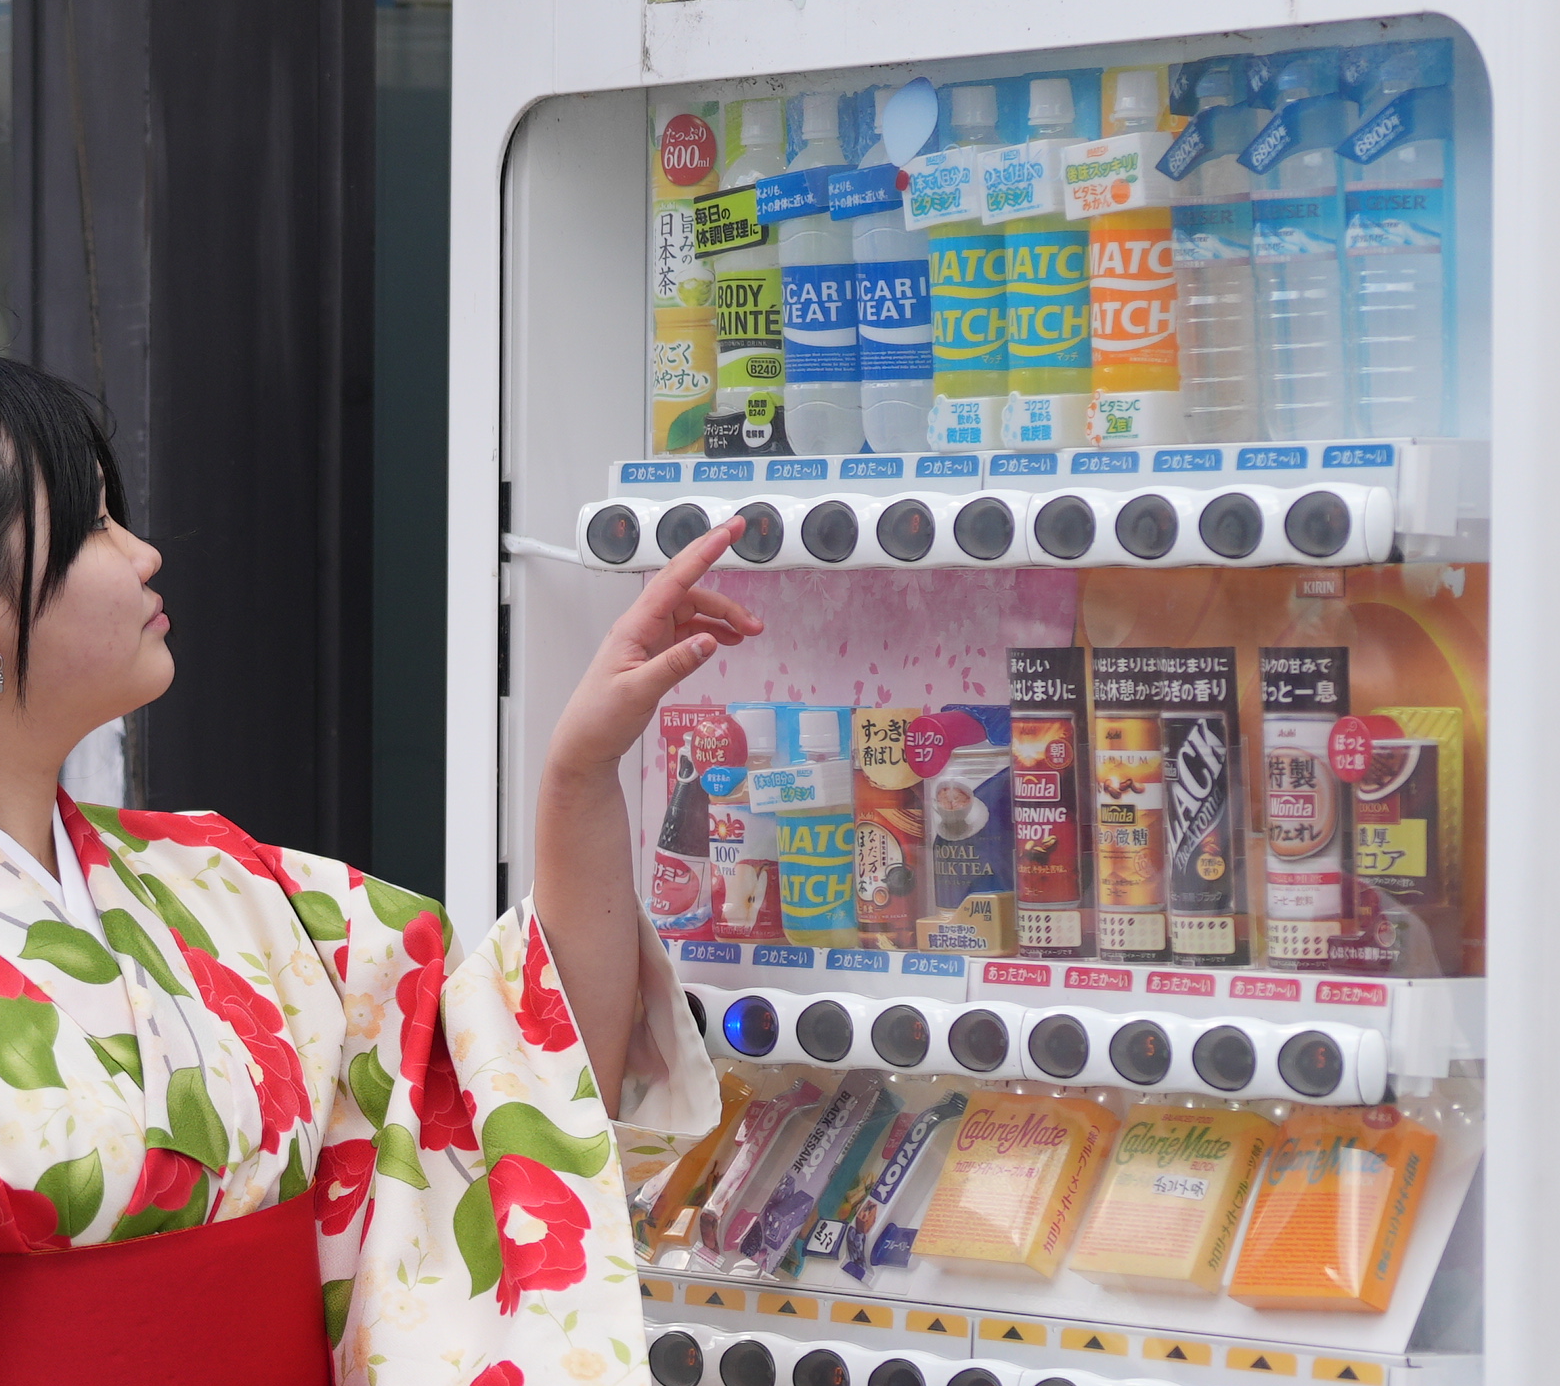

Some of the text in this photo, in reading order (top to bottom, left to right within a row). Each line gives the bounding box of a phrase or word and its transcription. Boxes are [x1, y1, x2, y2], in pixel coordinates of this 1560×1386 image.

[666, 126, 707, 144] たっぷり
[664, 144, 710, 169] 600ml
[987, 184, 1034, 211] ビタミン!
[1073, 184, 1108, 199] ビタミン
[912, 190, 960, 215] ビタミン!
[1082, 197, 1111, 211] みかん
[695, 204, 731, 226] 毎日の
[680, 213, 694, 265] 旨みの
[696, 219, 759, 249] 体調管理に
[659, 213, 677, 296] 日本茶
[718, 284, 764, 308] BODY
[982, 353, 1002, 363] マッチ
[1057, 352, 1079, 362] マッチ
[750, 364, 778, 376] B240
[749, 409, 766, 417] B240
[951, 403, 979, 413] ゴクゴク
[1025, 399, 1051, 412] ゴクゴク
[1099, 399, 1141, 413] ビタミンC
[957, 413, 981, 425] 飲める
[1030, 412, 1051, 423] 飲める
[1106, 414, 1133, 434] 2倍!
[946, 427, 982, 444] 微炭酸
[1021, 424, 1052, 442] 微炭酸
[708, 437, 728, 449] サポート
[998, 457, 1051, 473] つめた〜い
[1079, 455, 1132, 471] つめた〜い
[1161, 453, 1215, 469] つめた〜い
[1246, 451, 1300, 467] つめた〜い
[1330, 449, 1387, 465] つめた〜い
[628, 466, 677, 481] つめた〜い
[700, 465, 749, 480] つめた〜い
[773, 464, 821, 479] つめた〜い
[847, 462, 897, 478] つめた〜い
[924, 460, 974, 476] つめた〜い
[1303, 580, 1335, 594] KIRIN
[906, 731, 944, 746] ミルクの
[1278, 728, 1296, 738] Asahi
[1050, 743, 1065, 758] 朝
[1335, 734, 1365, 751] ほっと
[696, 749, 725, 763] おいしさ
[914, 748, 934, 762] コク
[1336, 754, 1366, 771] ひと息
[754, 771, 796, 790] 1本で1日分の
[1268, 758, 1316, 789] 特製
[781, 786, 815, 801] ビタミン!
[1015, 778, 1055, 797] Wonda
[1101, 809, 1134, 822] Wonda
[1271, 799, 1313, 816] Wonda
[709, 814, 745, 839] Dole
[1017, 824, 1053, 840] SHOT
[714, 845, 740, 863] 100%
[868, 829, 878, 873] なだ万
[936, 844, 980, 859] ROYAL
[715, 865, 736, 876] APPLE
[856, 831, 867, 894] ほうじ茶
[962, 862, 994, 876] TEA
[654, 881, 663, 894] C
[970, 900, 992, 916] JAVA
[938, 925, 976, 935] 豊かな香りの
[928, 933, 987, 949] 贅沢な味わい
[688, 946, 735, 960] つめた〜い
[760, 949, 808, 963] つめた〜い
[833, 953, 883, 968] つめた〜い
[909, 958, 958, 973] つめた〜い
[988, 968, 1047, 983] あったか〜い
[1069, 971, 1129, 988] あったか〜い
[1151, 976, 1211, 992] あったか〜い
[1234, 980, 1297, 997] あったか〜い
[1321, 985, 1383, 1003] あったか〜い
[793, 1091, 852, 1174] BLACK SESAME
[957, 1109, 1068, 1154] CalorieMate
[1116, 1121, 1231, 1169] CalorieMate
